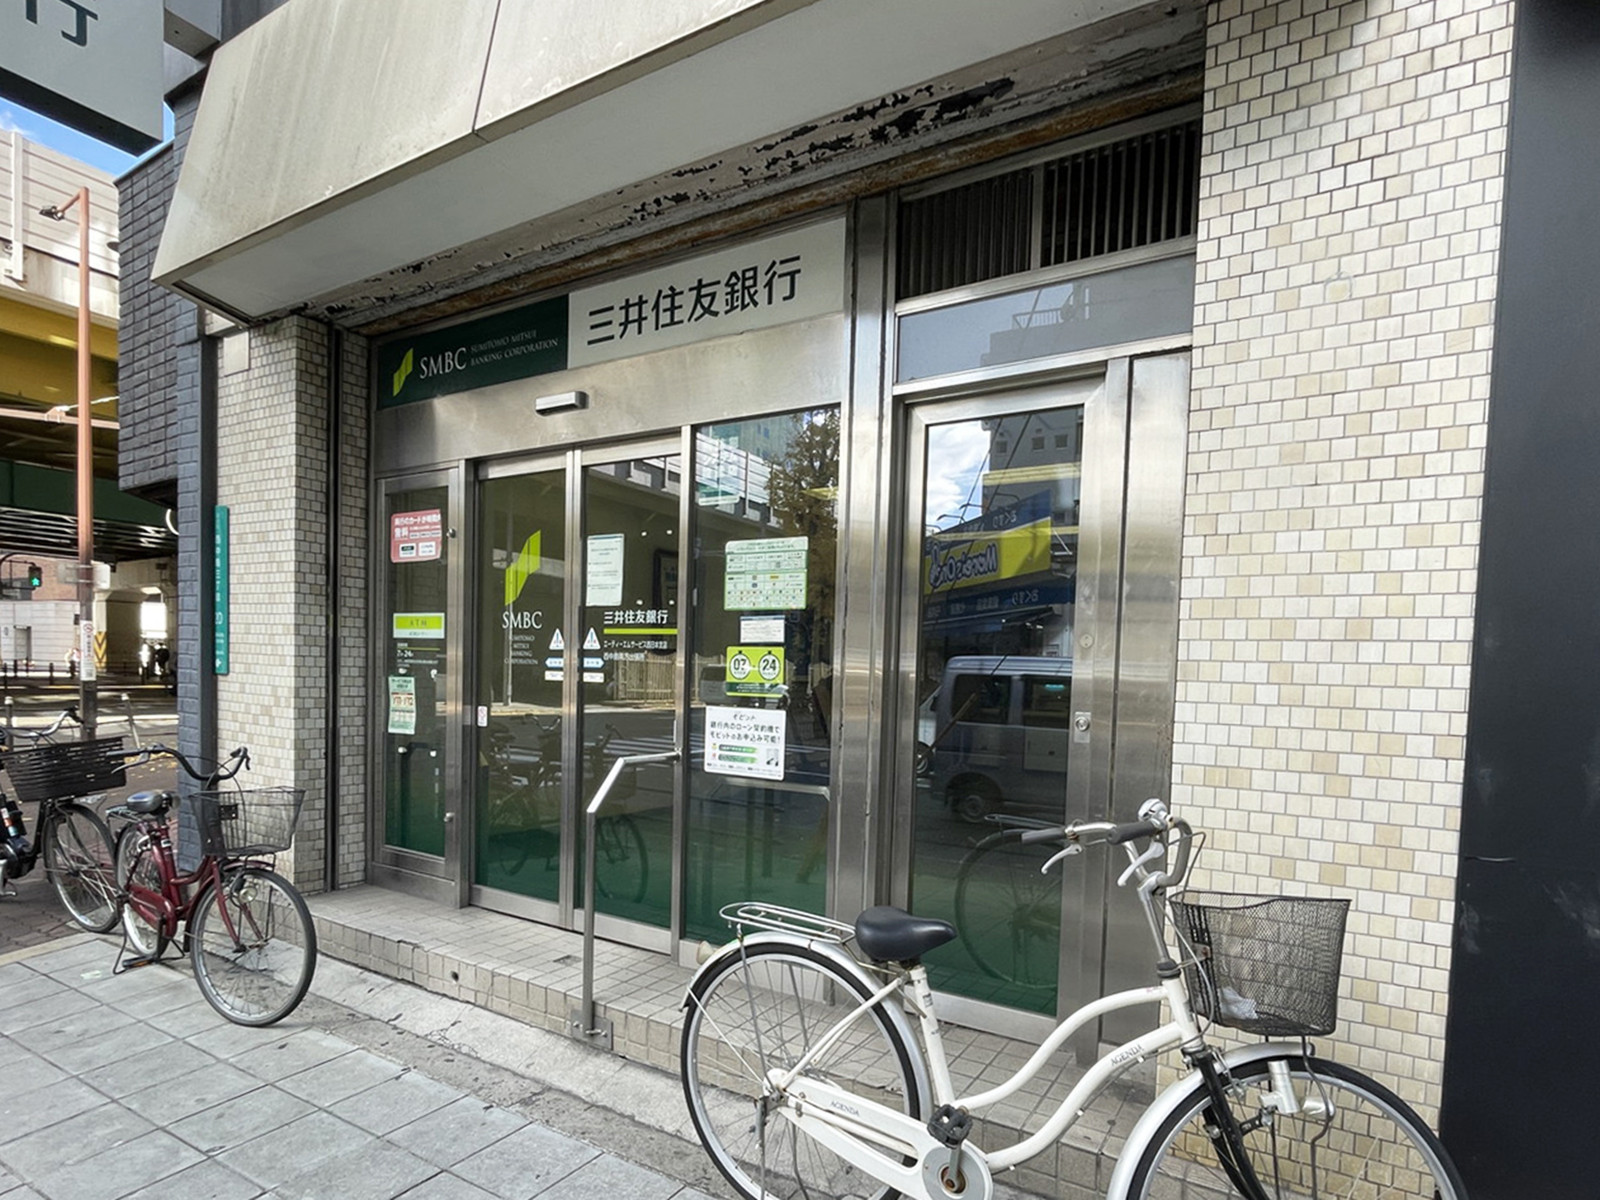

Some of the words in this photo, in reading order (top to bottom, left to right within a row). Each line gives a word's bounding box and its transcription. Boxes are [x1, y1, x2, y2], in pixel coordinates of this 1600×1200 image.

[587, 255, 801, 345] 三井住友銀行
[470, 335, 510, 354] SUMITOMO
[511, 329, 537, 346] MITSUI
[470, 350, 503, 367] BANKING
[504, 338, 559, 358] CORPORATION
[419, 347, 468, 379] SMBC
[502, 611, 543, 629] SMBC
[603, 609, 668, 625] 三井住友銀行
[763, 658, 777, 671] 24
[1110, 1043, 1144, 1066] AGENDA
[829, 1100, 860, 1117] AGENDA
